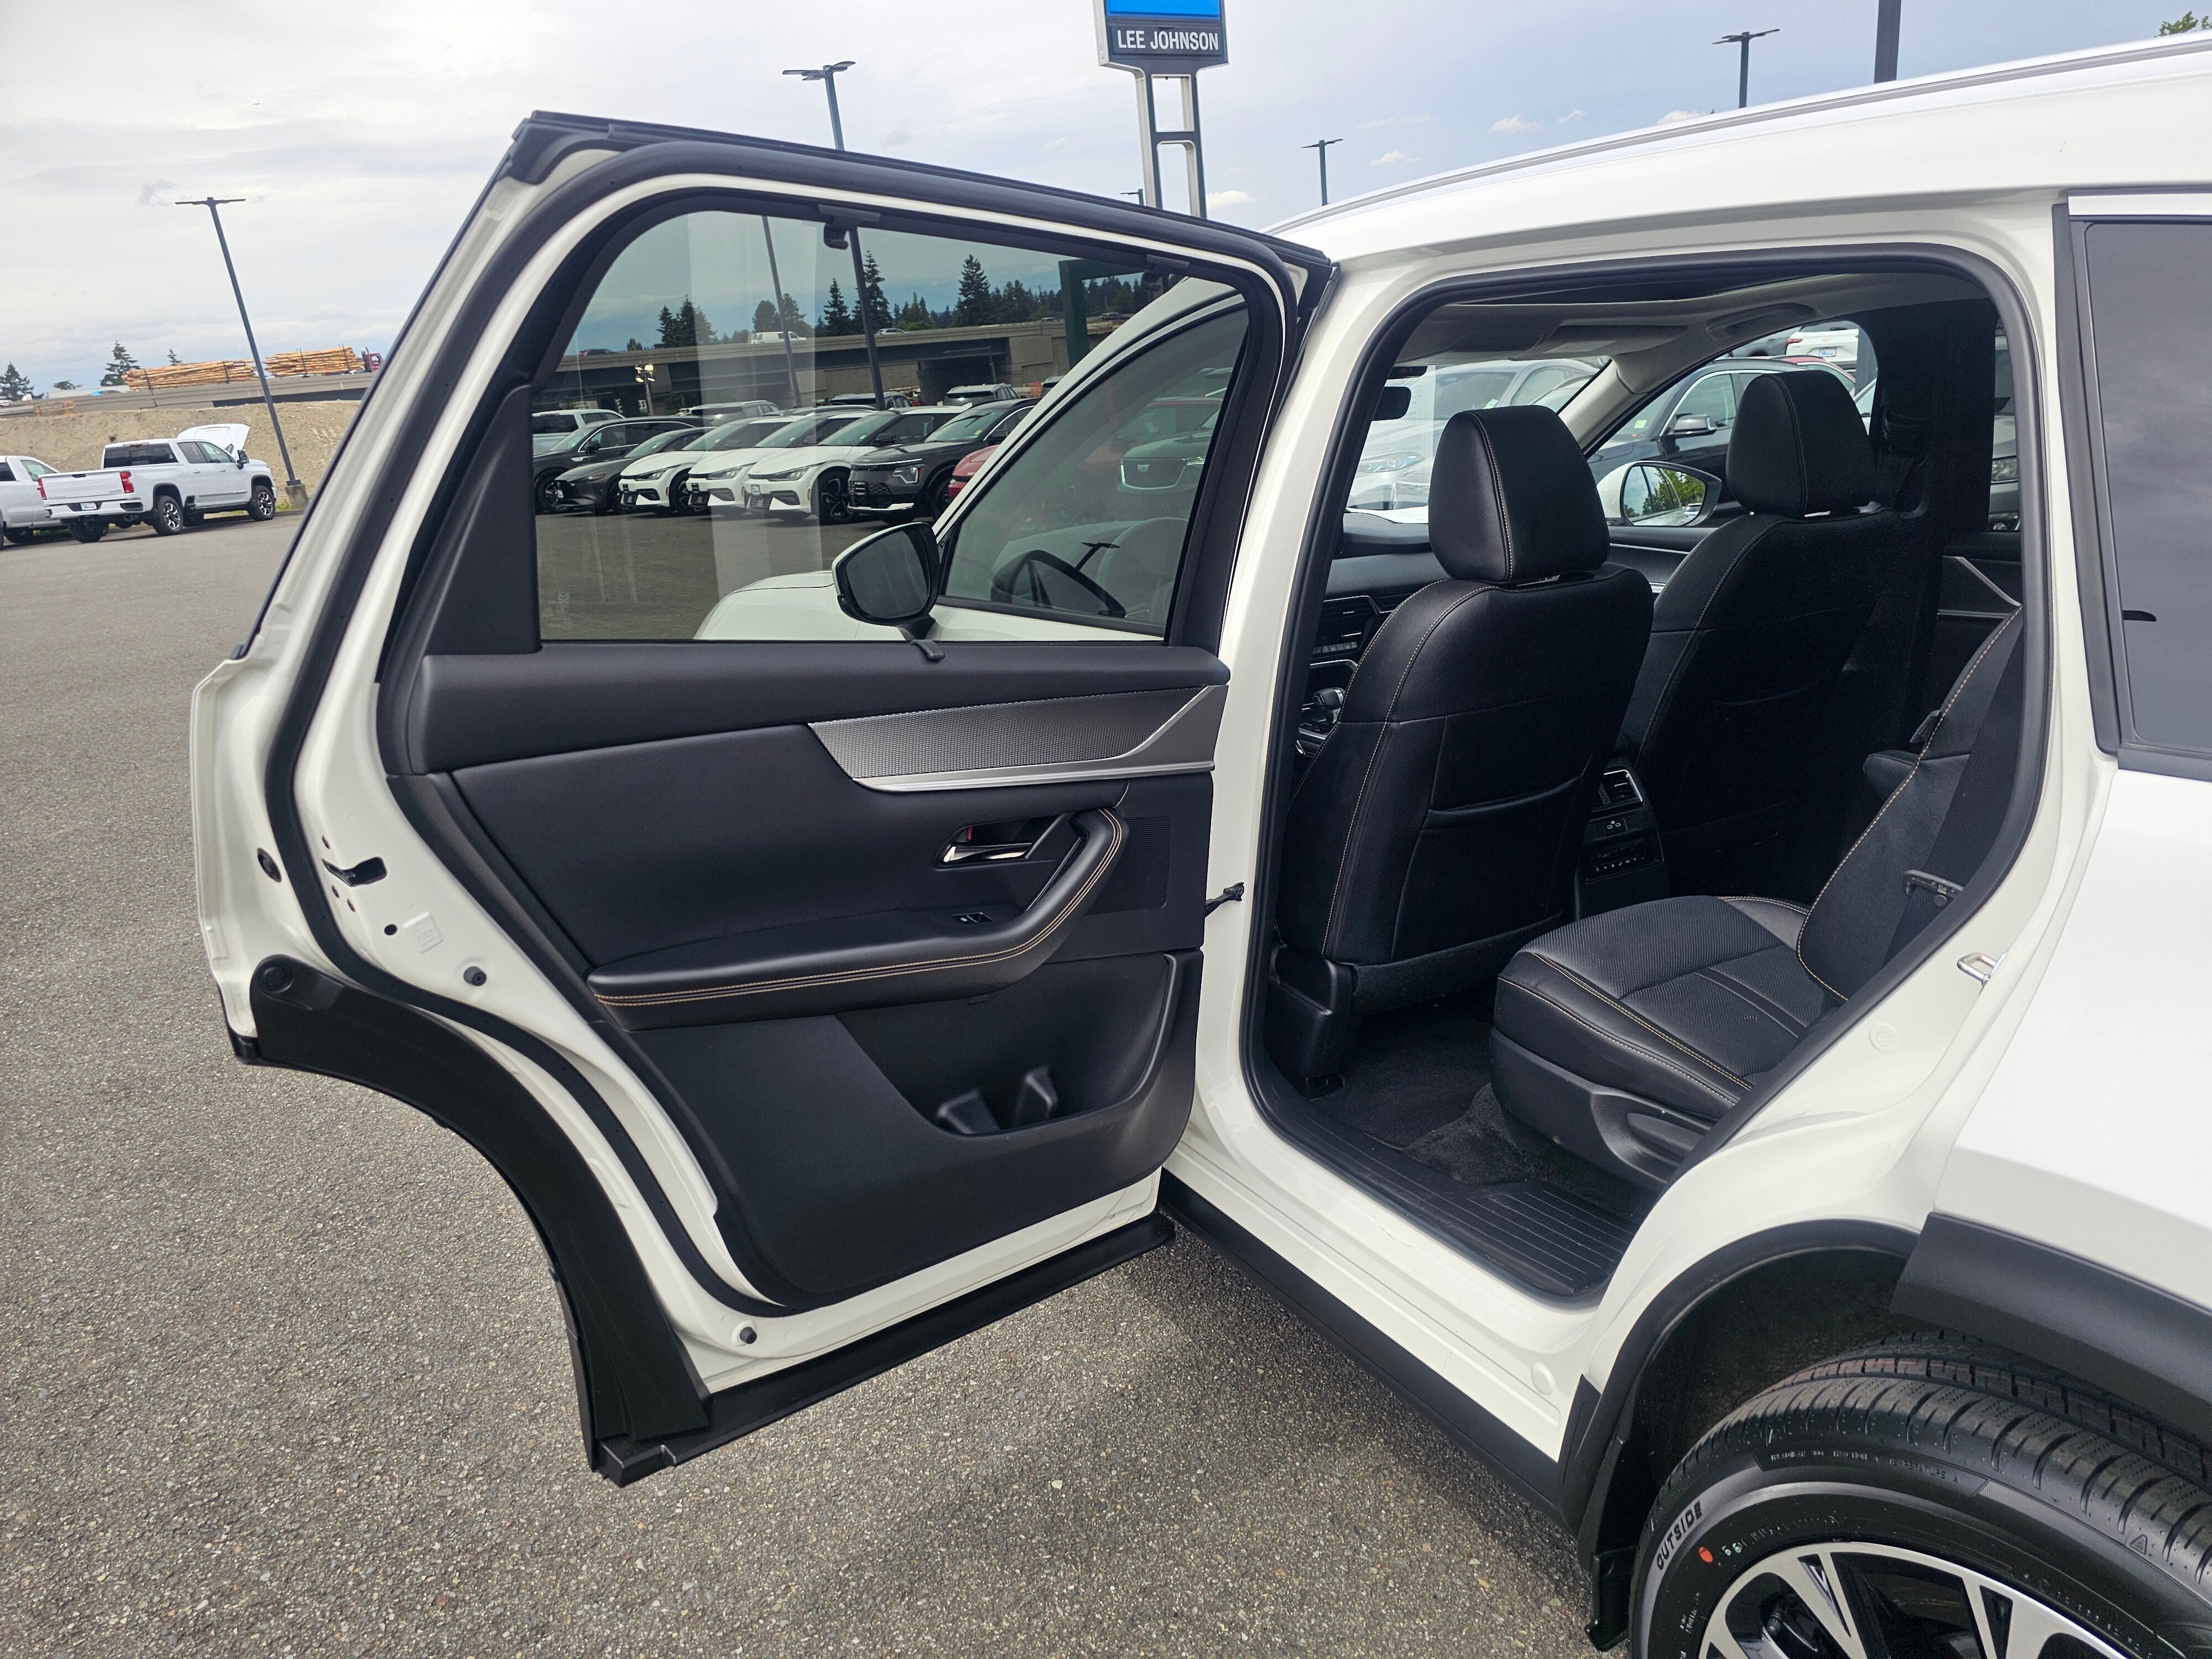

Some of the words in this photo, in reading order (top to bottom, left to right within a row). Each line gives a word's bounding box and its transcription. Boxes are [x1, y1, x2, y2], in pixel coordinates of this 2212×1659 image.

[1117, 30, 1146, 49] LEE
[1150, 31, 1219, 50] JOHNSON
[1657, 1500, 1702, 1571] OUTSIDE
